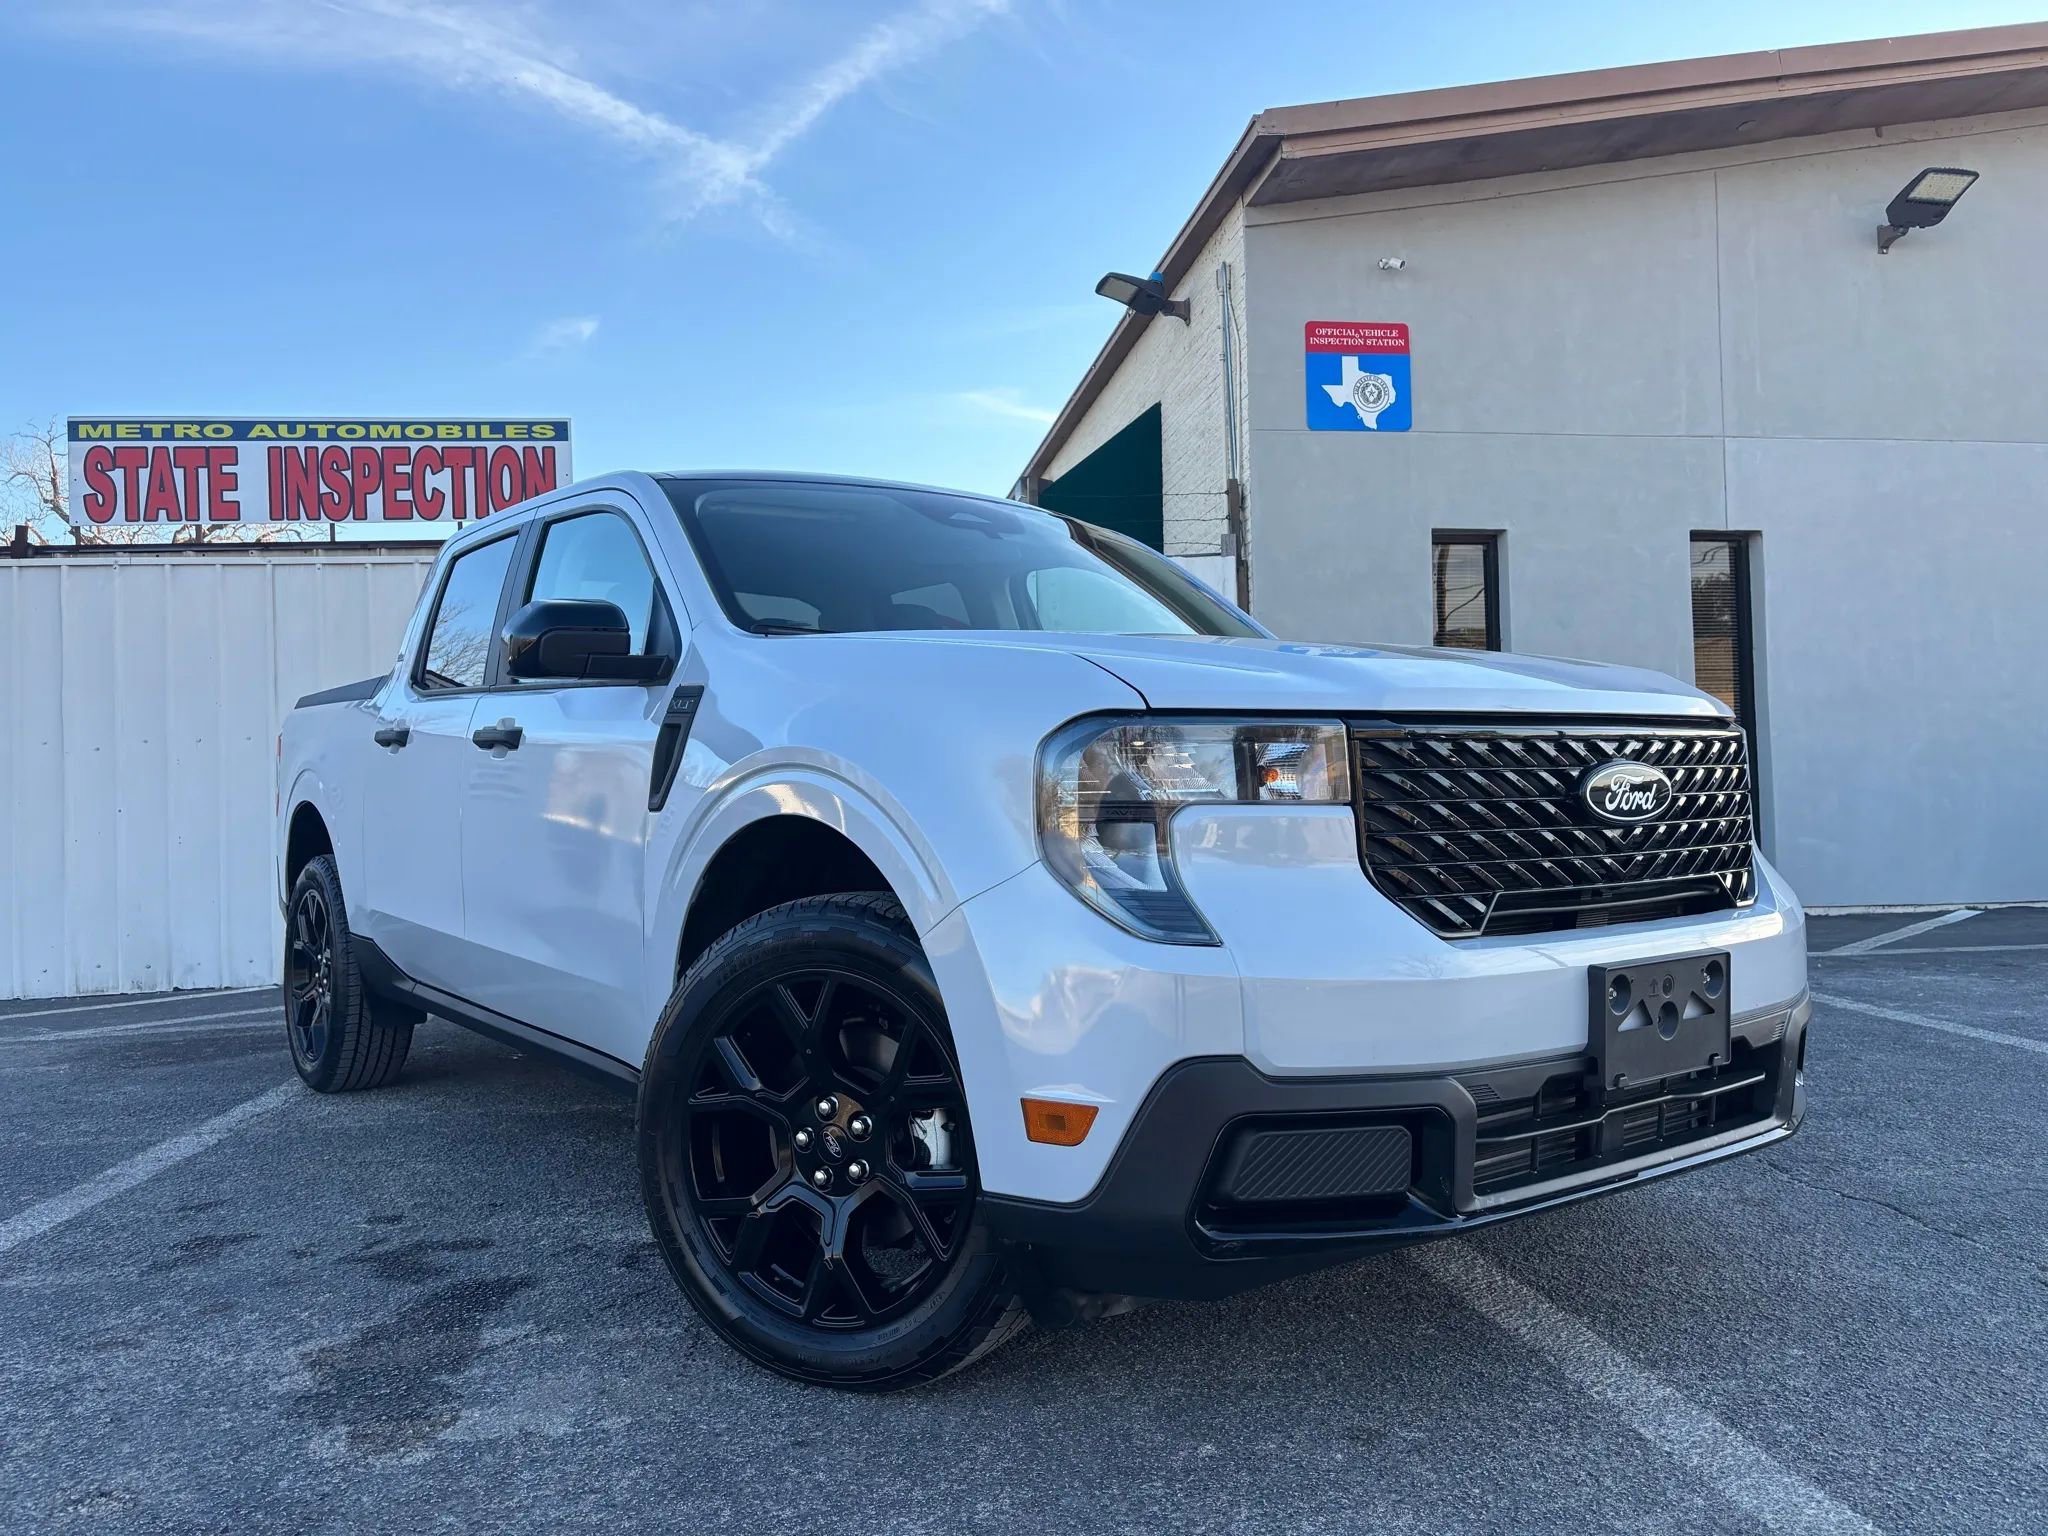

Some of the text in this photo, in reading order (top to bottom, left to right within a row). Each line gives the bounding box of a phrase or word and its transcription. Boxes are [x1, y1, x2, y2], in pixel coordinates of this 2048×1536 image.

[1315, 328, 1399, 337] OFFICIAL VEHICLE
[1310, 337, 1405, 347] INSPECTION STATION
[78, 423, 556, 439] METRO AUTOMOBILES
[83, 444, 557, 523] STATE INSPECTION
[1604, 773, 1658, 811] Ford
